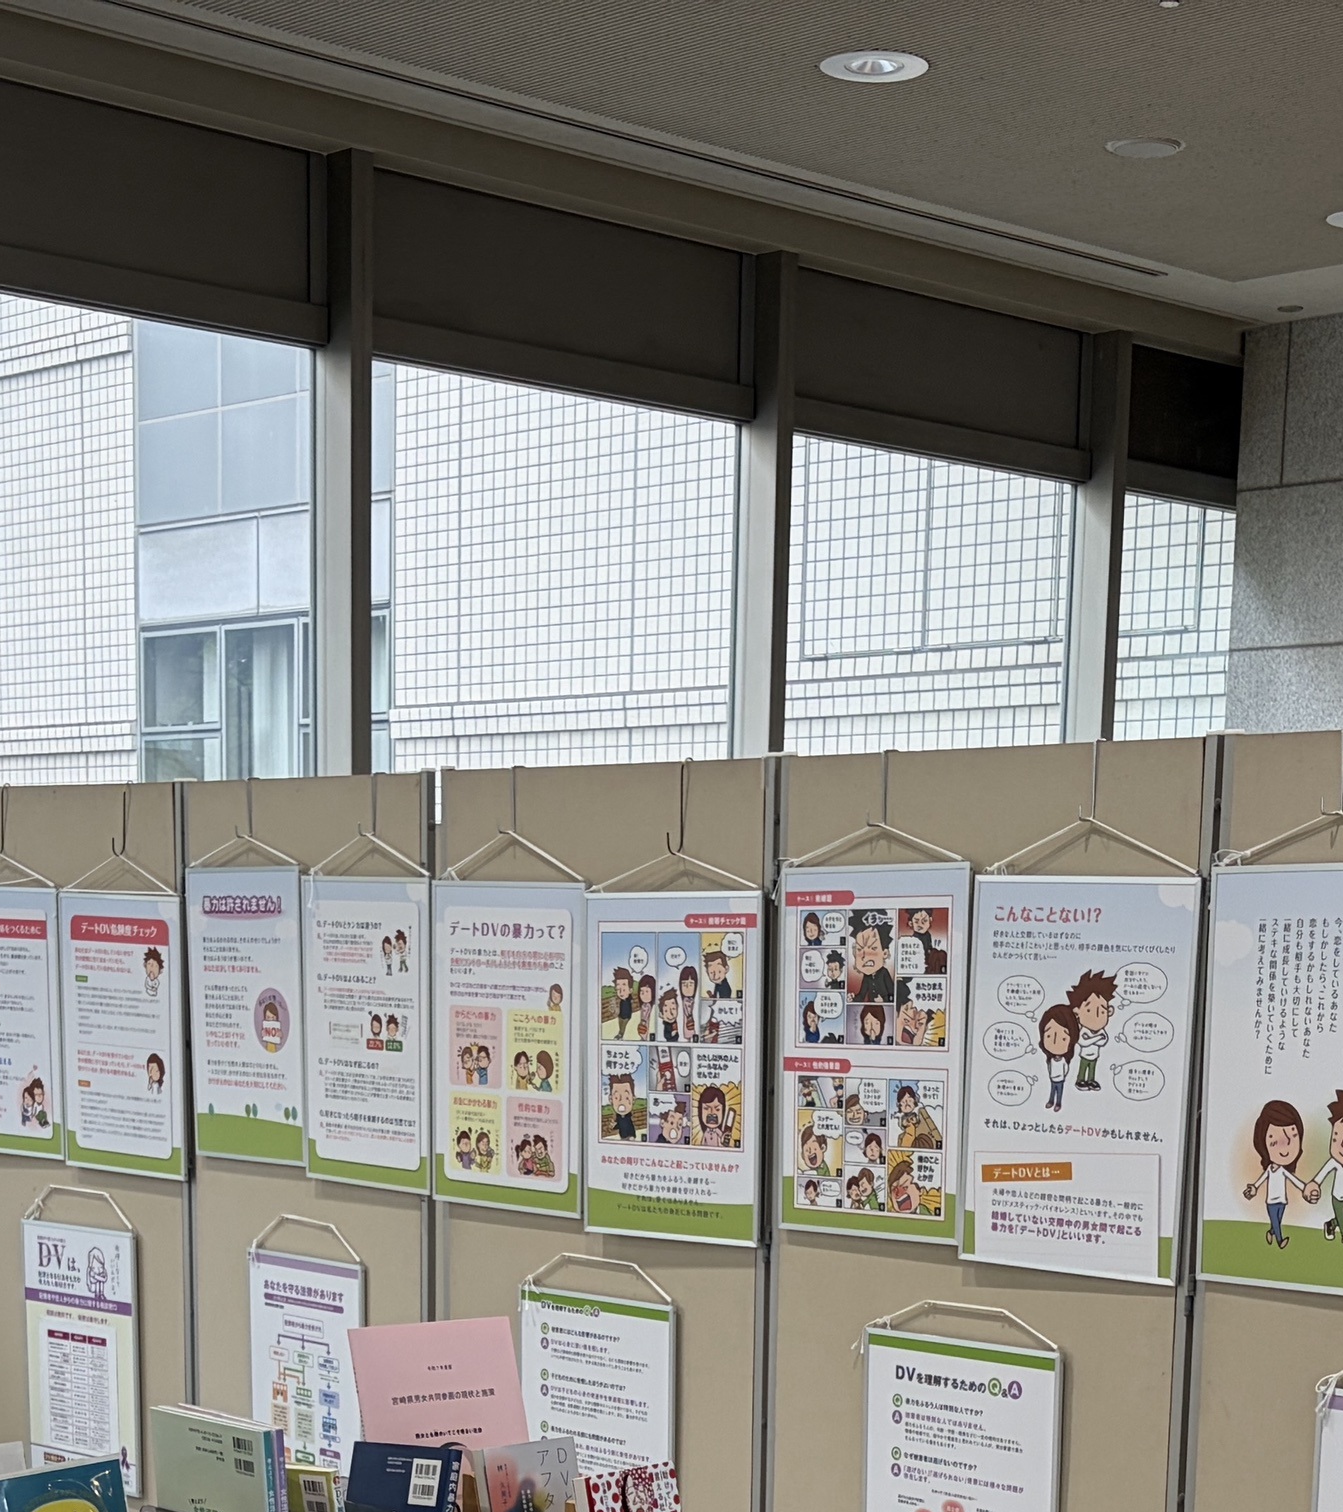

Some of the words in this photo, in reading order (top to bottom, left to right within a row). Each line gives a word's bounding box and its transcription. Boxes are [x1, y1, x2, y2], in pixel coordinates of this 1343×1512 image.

[203, 896, 282, 914] 暴力は許されません！
[81, 922, 157, 937] デートDV危険度チェック
[449, 920, 566, 940] デートDVの暴力って？
[993, 930, 1082, 940] 好きな人と交際しているはずなのに
[1254, 918, 1267, 1039] 一緒に考えてみませんか？
[1278, 918, 1292, 1051] 一緒に成長していけるような
[1291, 918, 1304, 1038] 自分も相手も大切にして
[1316, 918, 1330, 1034] もしかしたら、これから
[1329, 917, 1343, 1033] 今、恋をしているあなた
[915, 982, 943, 991] あたりまえ
[1264, 918, 1279, 1075] ステキな関係を築いていくために
[1302, 918, 1318, 1059] 恋をするかもしれないあなた
[455, 1010, 496, 1021] からだへの暴力
[513, 1013, 557, 1025] こころへの暴力
[606, 1049, 630, 1060] ちょっと
[696, 1053, 739, 1064] わたし以外の人と
[518, 1103, 550, 1114] 性的な暴力
[984, 1118, 1164, 1143] それは、ひょっとしたらデートDVかもしれません。
[601, 1155, 739, 1173] あなたの周りでこんなこと起こっていませんか？
[992, 1188, 1144, 1211] 夫婦や恋人などの親密な間柄で起こる暴力を、一般的に
[991, 1211, 1142, 1236] 結婚していない交際中の男女間で起こる
[991, 1222, 1106, 1245] 暴力を「デートDV」といいます。
[37, 1241, 81, 1273] DVは、
[263, 1279, 345, 1303] あなたを守る法律があります
[895, 1364, 1022, 1400] DVを理解するためのQ&A
[391, 1388, 495, 1406] 宮崎県男女共同参画の現状と施策
[905, 1397, 983, 1417] 暴力をふるう人は特別な人ですか？
[905, 1411, 986, 1432] 加害者は特別な人ではありません。
[904, 1451, 977, 1471] なぜ被害者は逃げないのですか？
